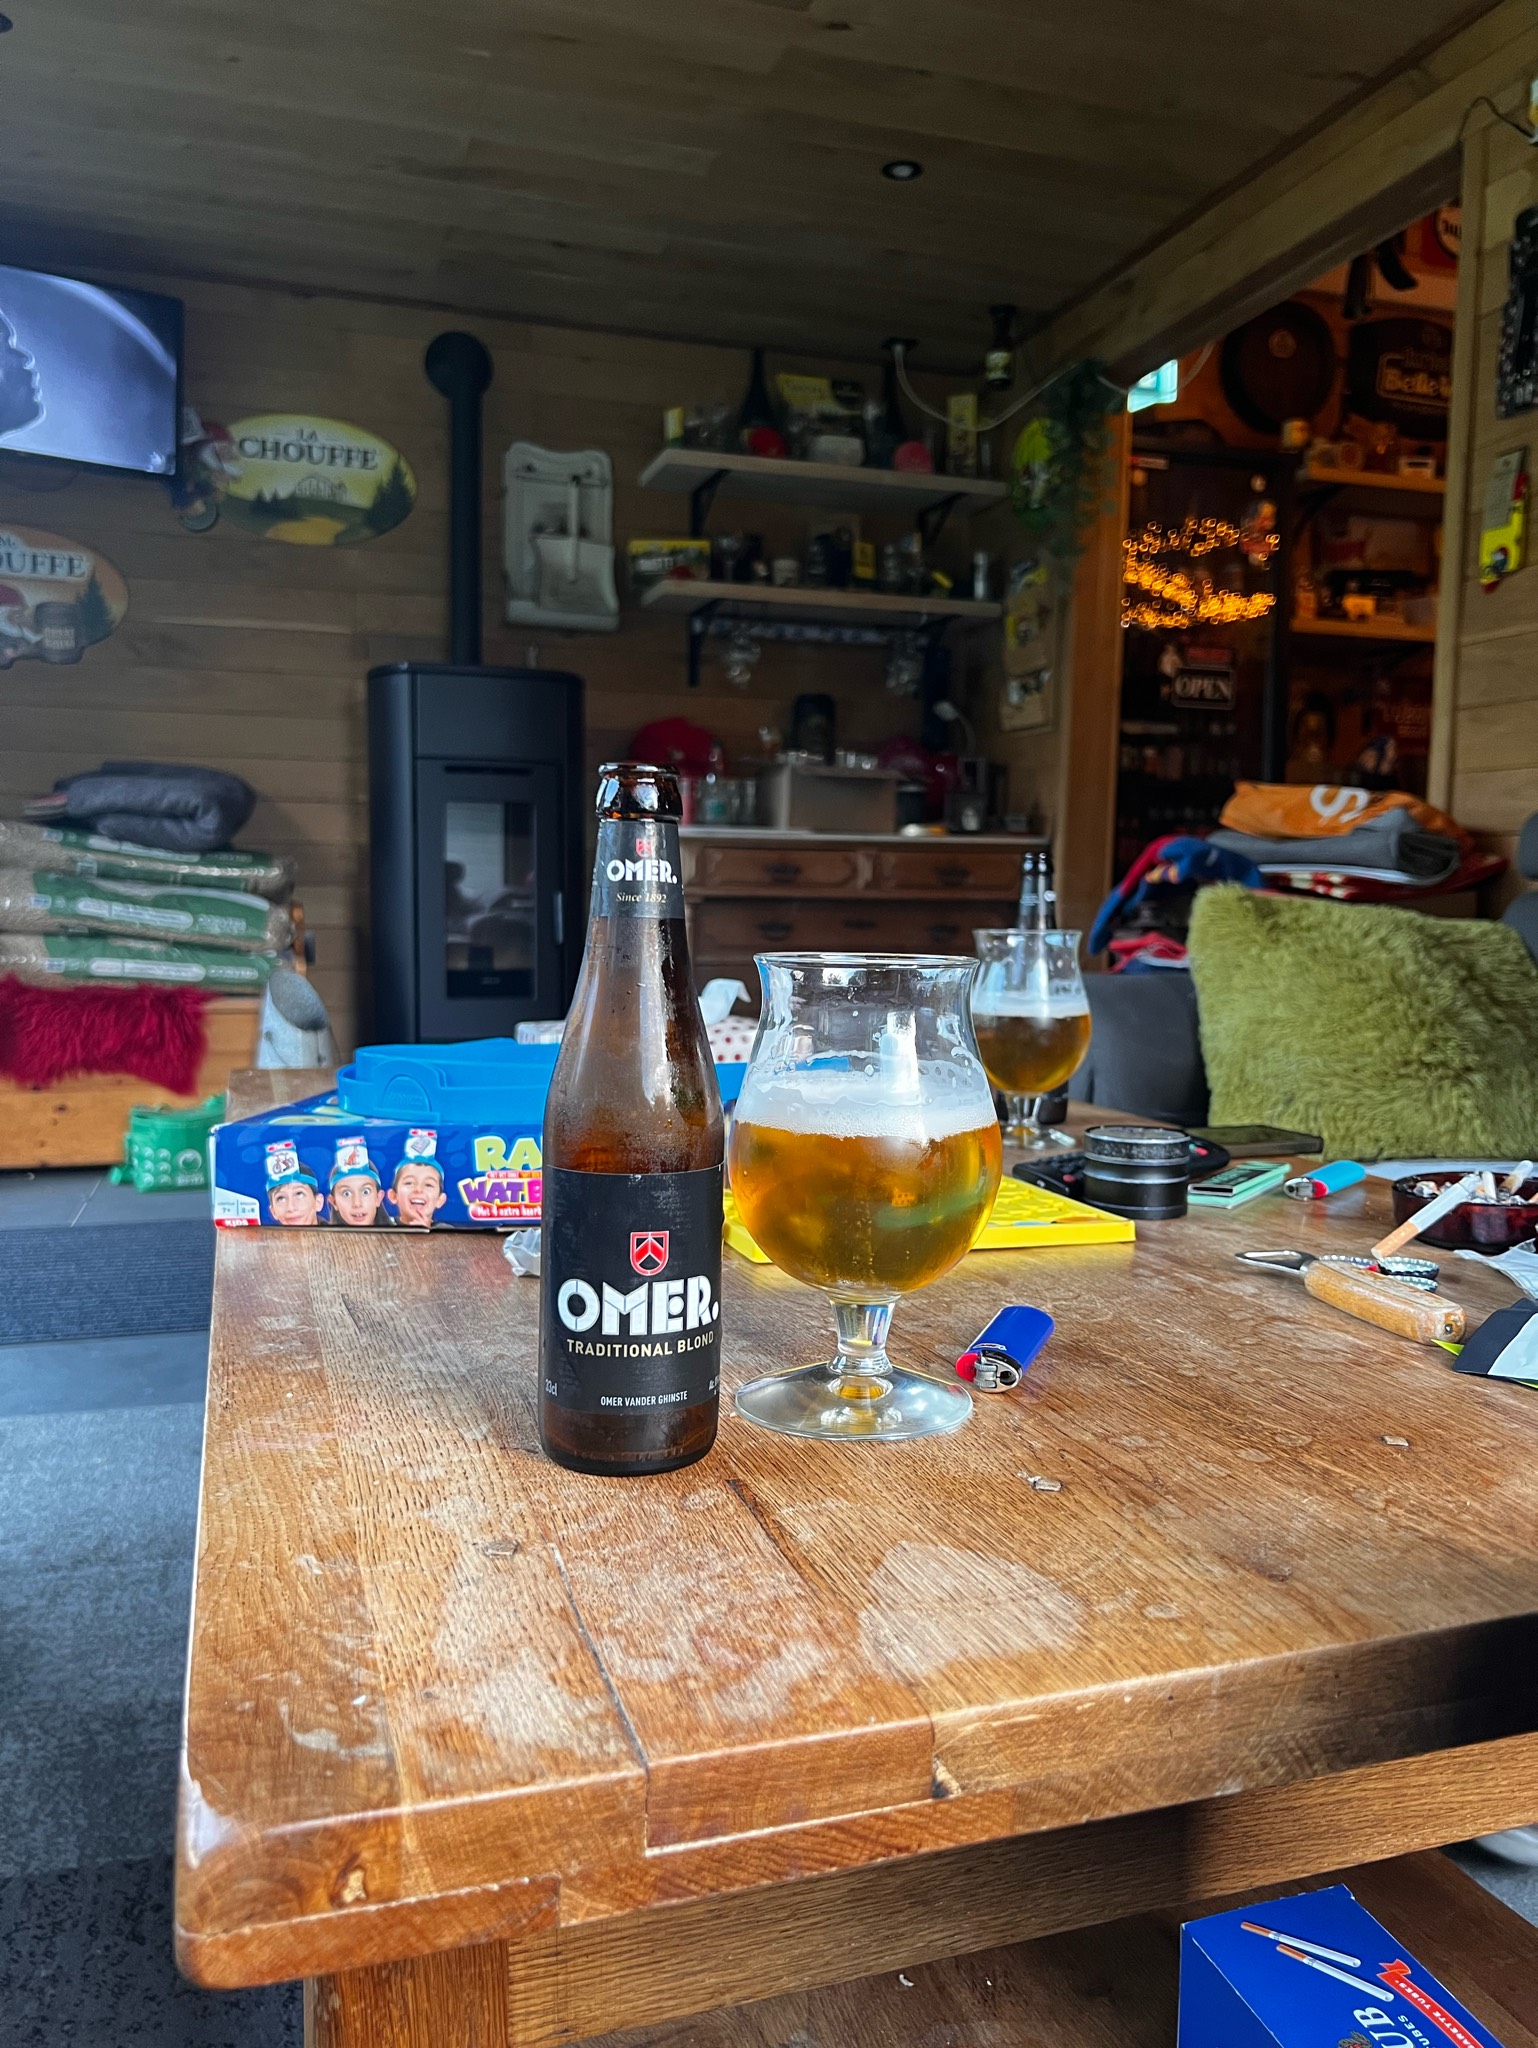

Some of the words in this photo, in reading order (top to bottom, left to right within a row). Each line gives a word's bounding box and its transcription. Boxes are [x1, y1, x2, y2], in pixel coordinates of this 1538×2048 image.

[296, 428, 318, 442] LA
[239, 436, 378, 470] CHOUFFE
[1175, 675, 1231, 700] OPEN
[607, 859, 678, 884] OMER.
[616, 892, 642, 902] Since
[645, 893, 667, 903] 1892
[474, 1136, 543, 1171] RA
[499, 1207, 520, 1217] extra
[557, 1275, 719, 1336] OMER.
[566, 1338, 673, 1358] TRADITIONAL
[677, 1330, 714, 1354] BLOND
[600, 1396, 623, 1407] OMER
[624, 1395, 656, 1407] VANDER
[658, 1390, 688, 1404] GHINSTE
[1397, 2014, 1435, 2048] UBES
